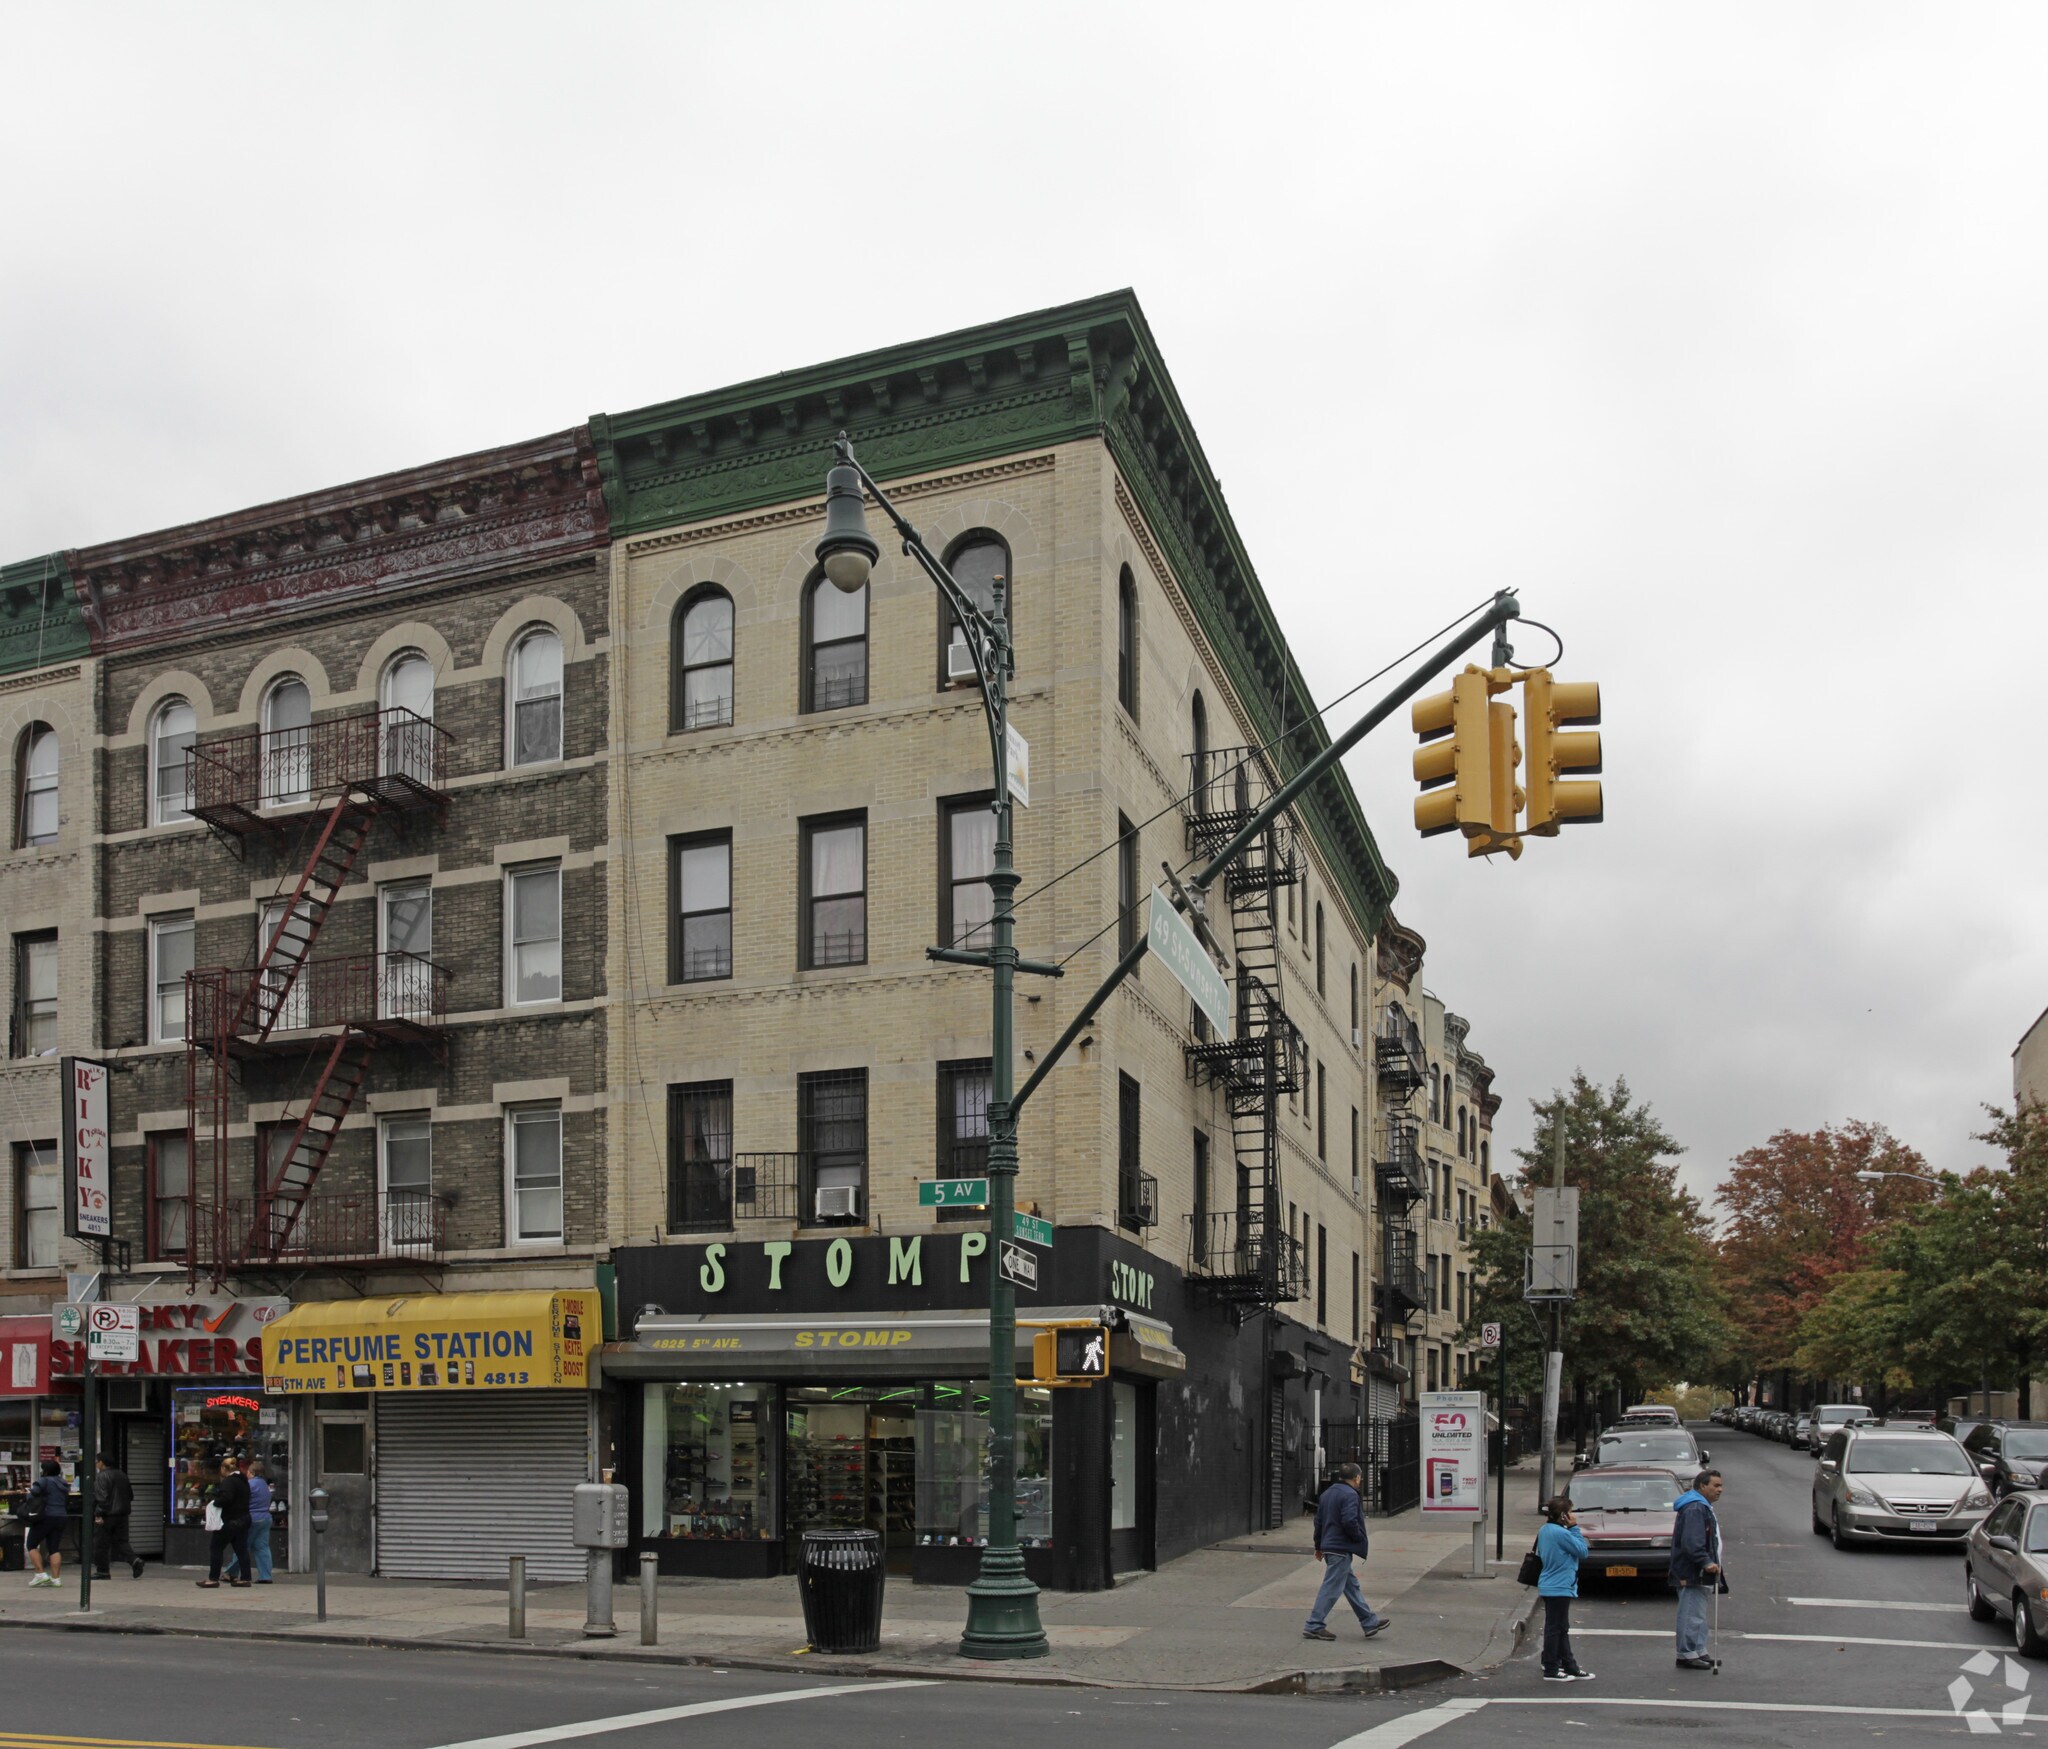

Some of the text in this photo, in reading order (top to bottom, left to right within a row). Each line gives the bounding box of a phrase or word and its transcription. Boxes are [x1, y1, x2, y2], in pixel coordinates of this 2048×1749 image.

[1154, 914, 1169, 945] 49
[77, 1068, 92, 1208] RICKY
[934, 1183, 973, 1203] 5 AV
[79, 1213, 108, 1224] SNEAKERS
[1021, 1216, 1039, 1230] 49 ST
[88, 1224, 101, 1232] 4813
[700, 1232, 987, 1293] STOMP
[1008, 1256, 1034, 1277] ONE WAY
[1112, 1259, 1154, 1310] STOMP
[562, 1298, 584, 1315] T-MOBILE
[138, 1304, 200, 1329] CKY
[279, 1330, 533, 1364] PERFUME STATION
[552, 1298, 562, 1384] PERFUME STATION
[563, 1340, 584, 1356] NEXTEL
[653, 1339, 686, 1349] 4825
[794, 1331, 912, 1348] STOMP
[563, 1361, 583, 1377] BOOST
[283, 1377, 326, 1390] 5TH AVE
[484, 1371, 529, 1385] 4813
[206, 1395, 259, 1411] SNEAKERS
